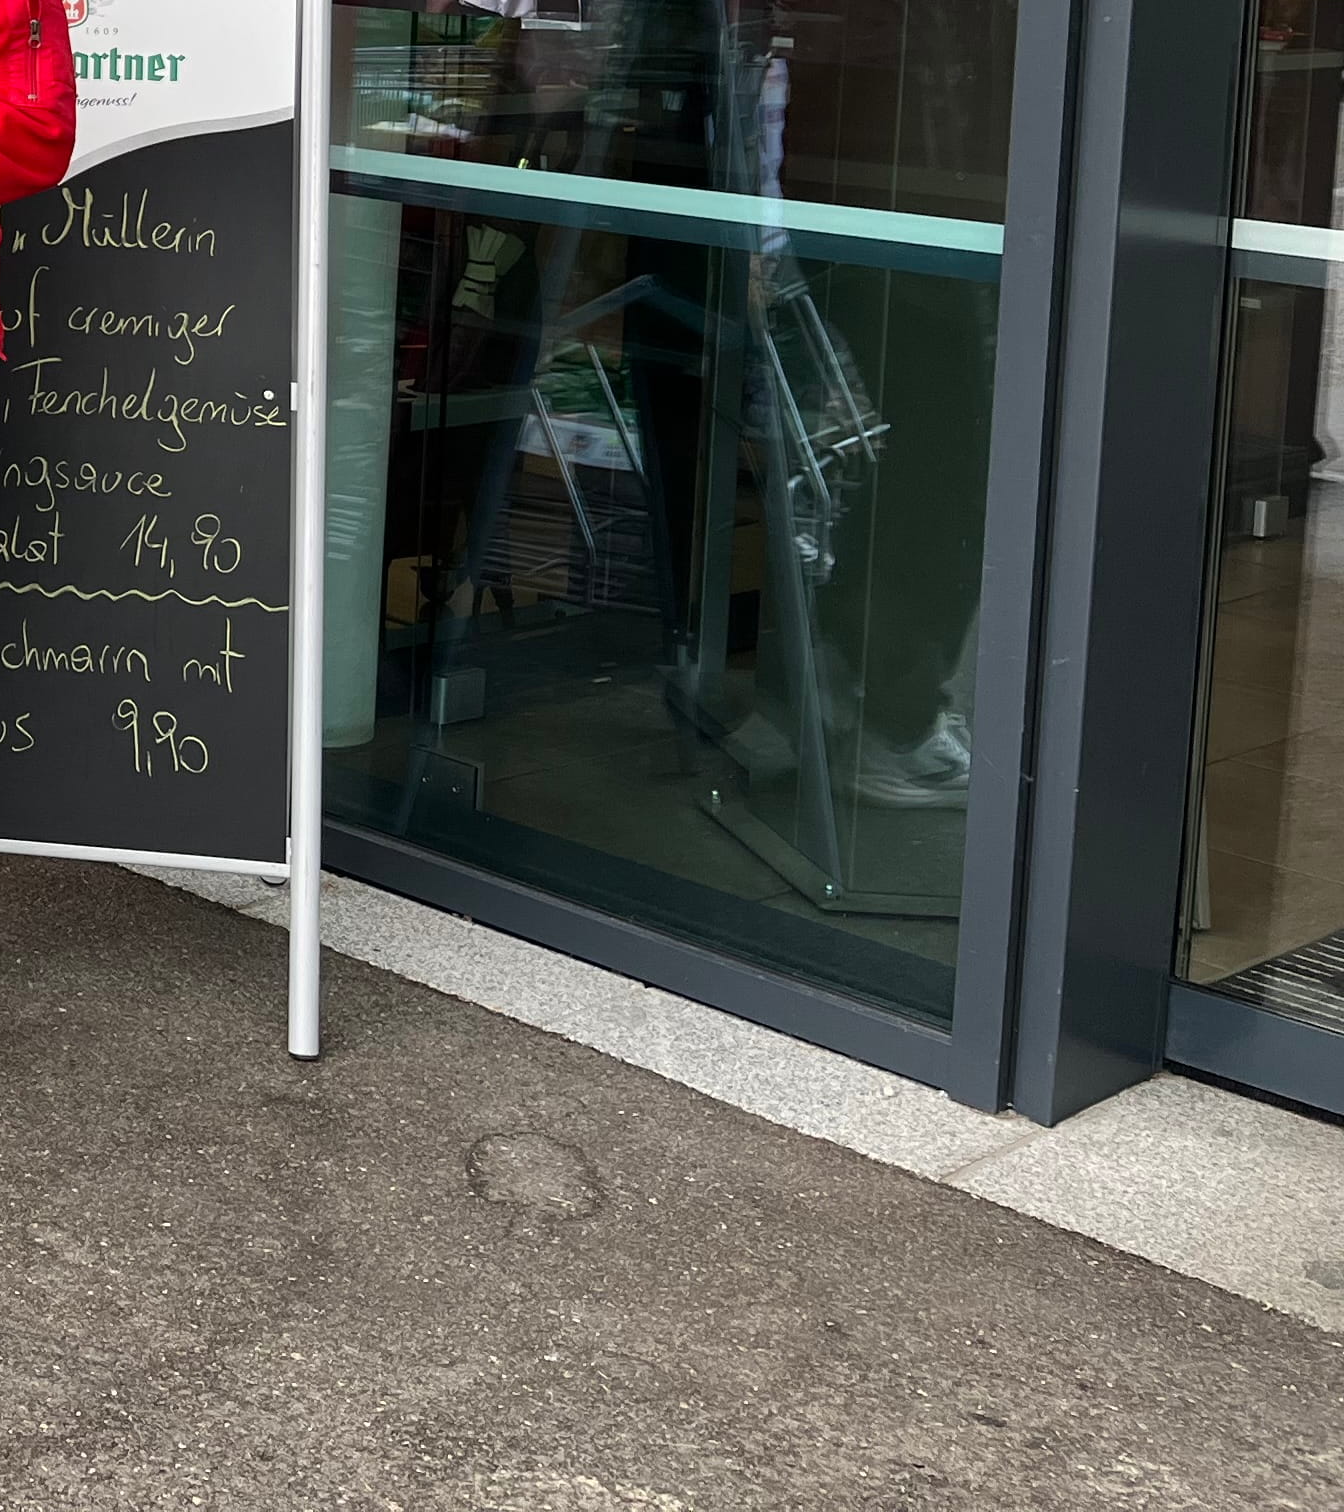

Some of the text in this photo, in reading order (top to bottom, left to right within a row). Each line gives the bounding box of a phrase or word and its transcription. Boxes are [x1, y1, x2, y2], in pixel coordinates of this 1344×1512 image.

[74, 47, 186, 82] artner
[86, 27, 120, 35] 1609
[11, 356, 288, 453] Fenchelgemüse
[119, 513, 242, 579] 14,90
[183, 617, 246, 693] mit
[112, 698, 209, 778] 9,90
